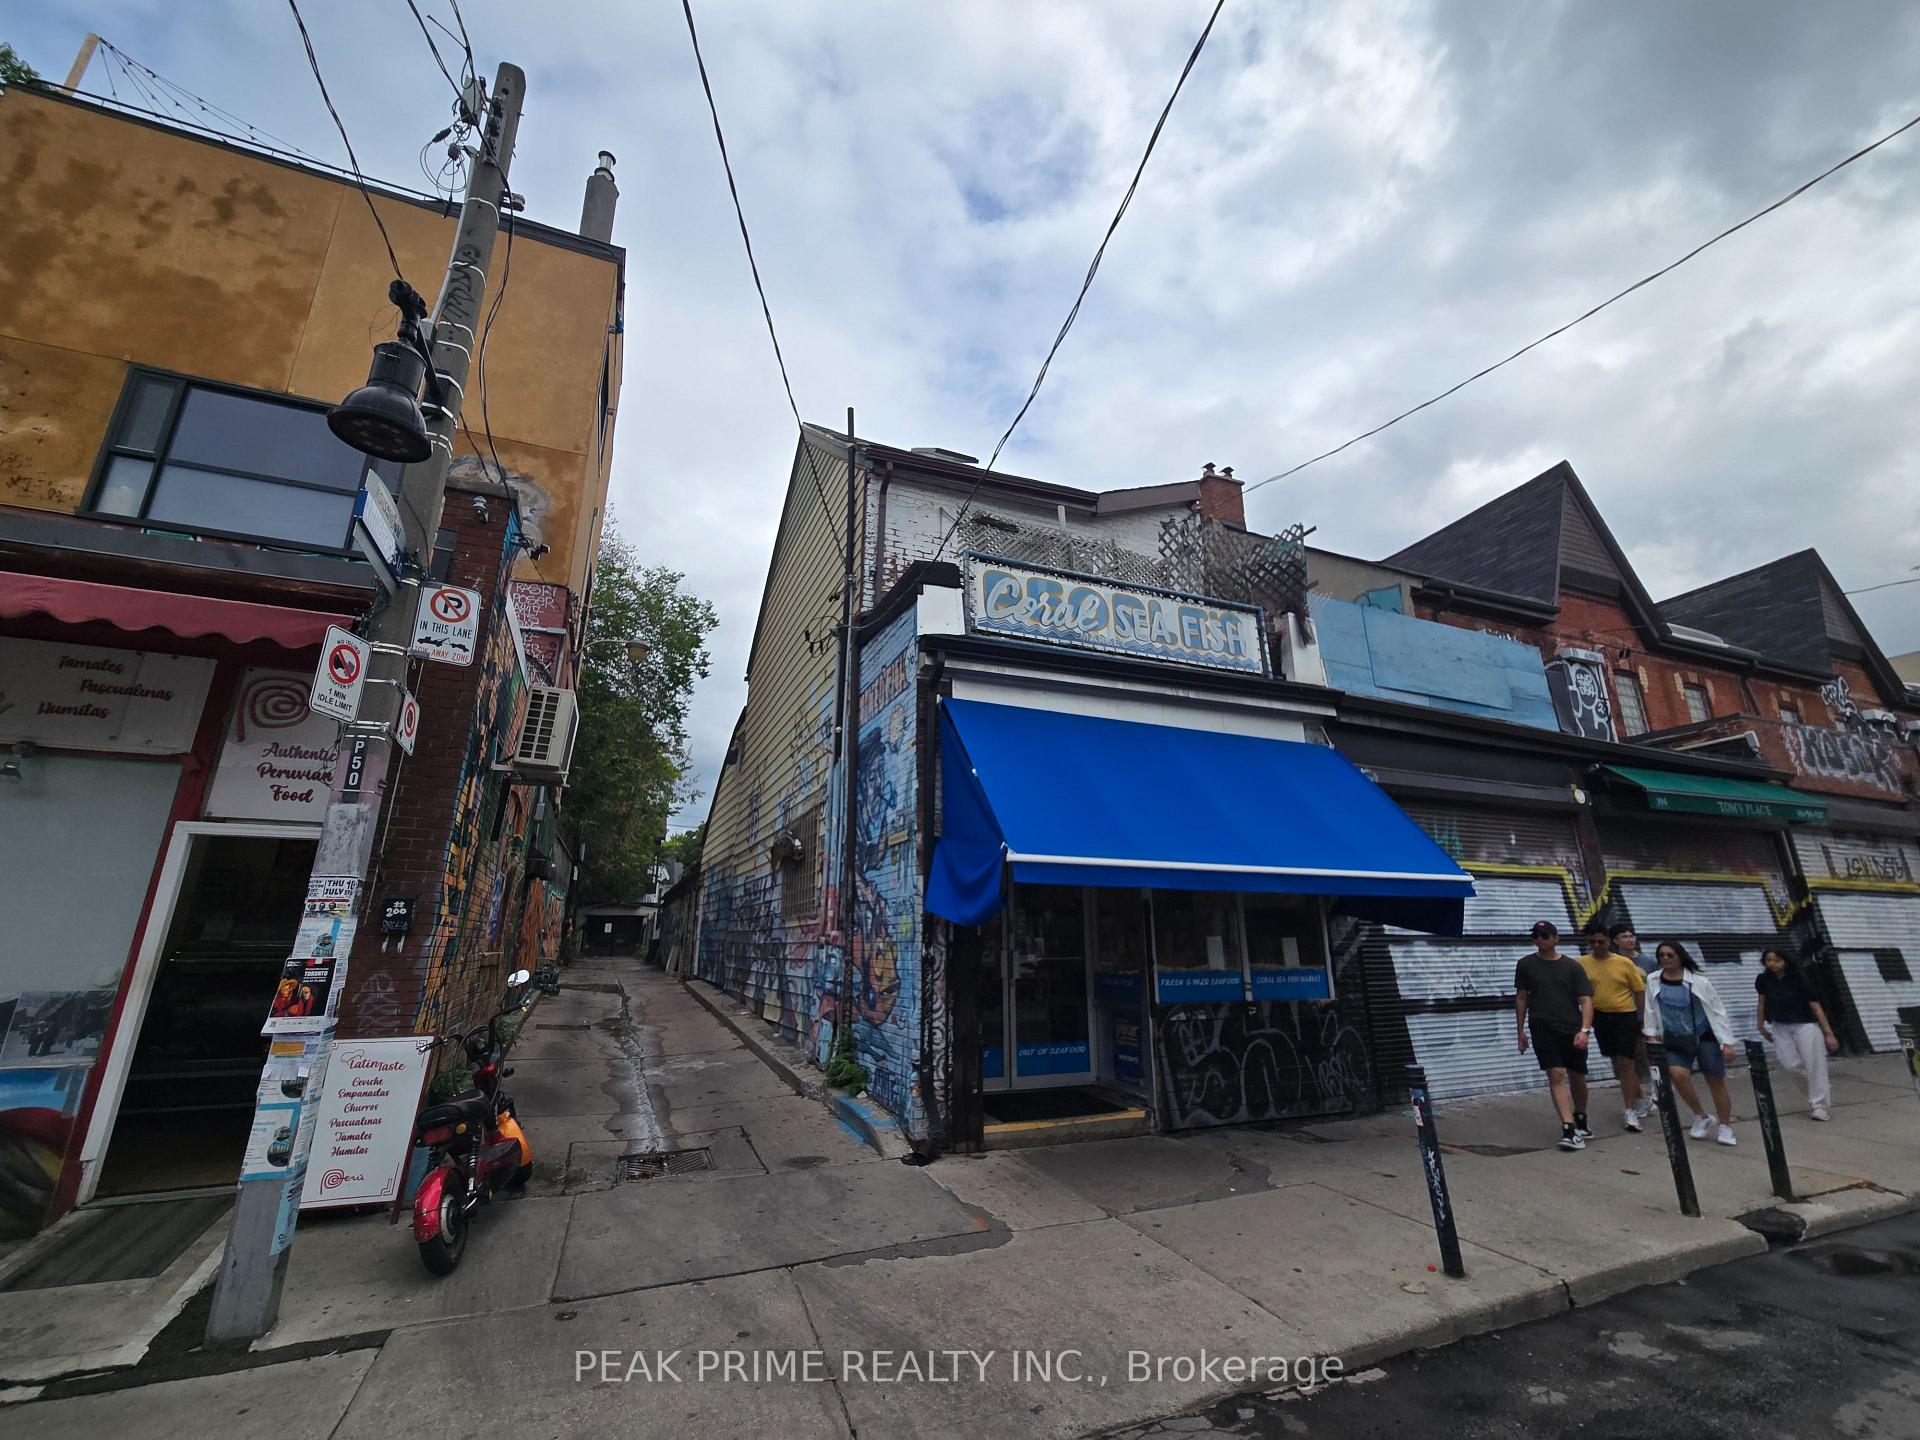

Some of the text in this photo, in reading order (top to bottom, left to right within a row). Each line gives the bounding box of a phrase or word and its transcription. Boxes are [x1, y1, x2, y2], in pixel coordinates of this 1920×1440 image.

[985, 576, 1247, 657] Coral SEA FISH
[419, 620, 473, 640] IN THIS LANE
[431, 650, 449, 659] AWAY
[451, 653, 470, 663] ZONE
[57, 655, 126, 675] Tamales
[79, 679, 175, 702] Pascualinas
[333, 690, 347, 700] MIN
[317, 693, 334, 705] IDLE
[334, 698, 353, 713] LIMIT
[37, 701, 112, 719] Humitas
[261, 742, 337, 762] Authentic
[256, 762, 334, 782] Peruvian
[270, 784, 314, 802] Food
[385, 907, 407, 918] 200
[1018, 1049, 1034, 1057] OUT
[352, 1076, 384, 1087] Ceviche
[338, 1087, 390, 1100] Empanadas
[344, 1103, 379, 1113] Churros
[329, 1116, 382, 1128] Pascualinas
[334, 1131, 373, 1142] Tamales
[330, 1145, 369, 1157] Humitas
